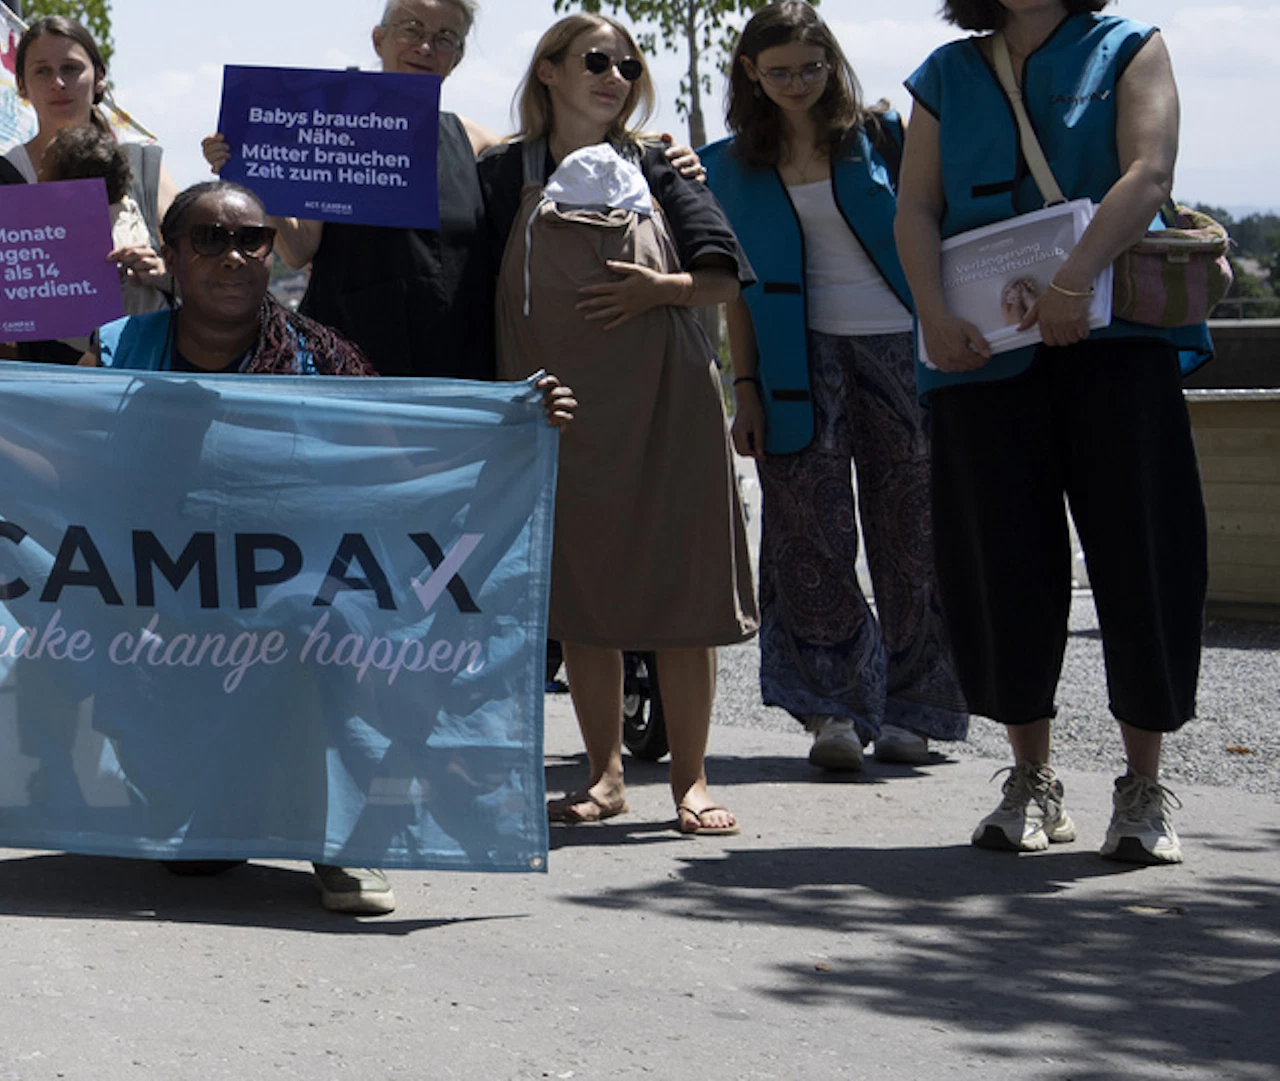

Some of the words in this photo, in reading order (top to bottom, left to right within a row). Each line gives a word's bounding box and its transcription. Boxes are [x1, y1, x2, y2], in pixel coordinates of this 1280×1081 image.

[249, 107, 308, 127] Babys
[312, 109, 409, 131] brauchen
[298, 127, 356, 147] Nähe.
[241, 144, 309, 162] Mütter
[314, 147, 410, 169] brauchen
[246, 162, 285, 180] Zeit
[289, 169, 333, 183] zum
[338, 168, 409, 188] Heilen.
[4, 263, 33, 281] als
[36, 262, 60, 279] 14
[4, 279, 98, 301] verdient.
[108, 613, 288, 694] change
[299, 612, 484, 686] happen
